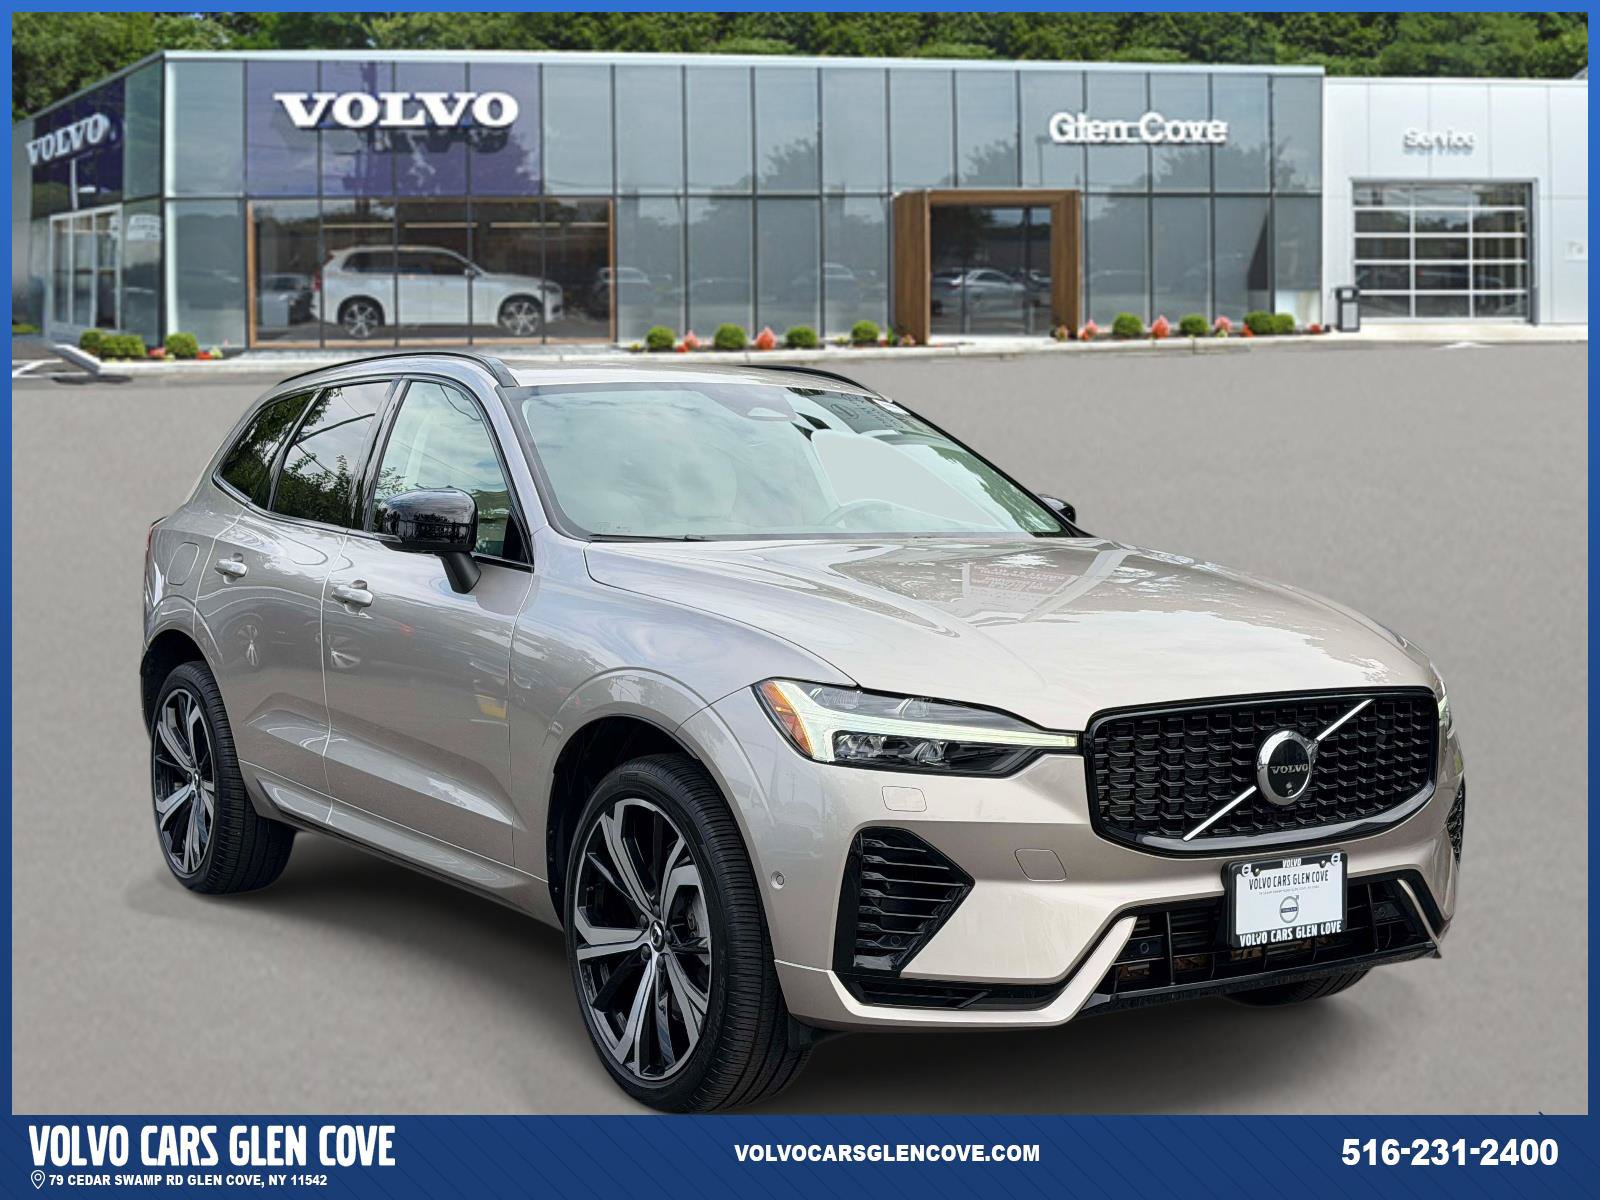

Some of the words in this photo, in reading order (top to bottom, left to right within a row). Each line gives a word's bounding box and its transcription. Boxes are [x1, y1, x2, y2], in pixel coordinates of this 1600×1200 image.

[274, 92, 519, 127] VOLVO
[26, 112, 110, 165] VOLVO
[1049, 111, 1128, 144] Glen
[1138, 111, 1229, 144] Cove
[1402, 128, 1476, 153] Service
[1270, 763, 1309, 775] VOLVO
[1282, 858, 1302, 868] VOLVO
[1249, 876, 1272, 890] VOLVO
[1273, 874, 1291, 888] CARS
[1292, 871, 1310, 885] GLEN
[1311, 870, 1329, 882] COVE
[1239, 931, 1268, 948] VOLVO
[1270, 927, 1294, 943] CARS
[1295, 923, 1318, 939] GLEN
